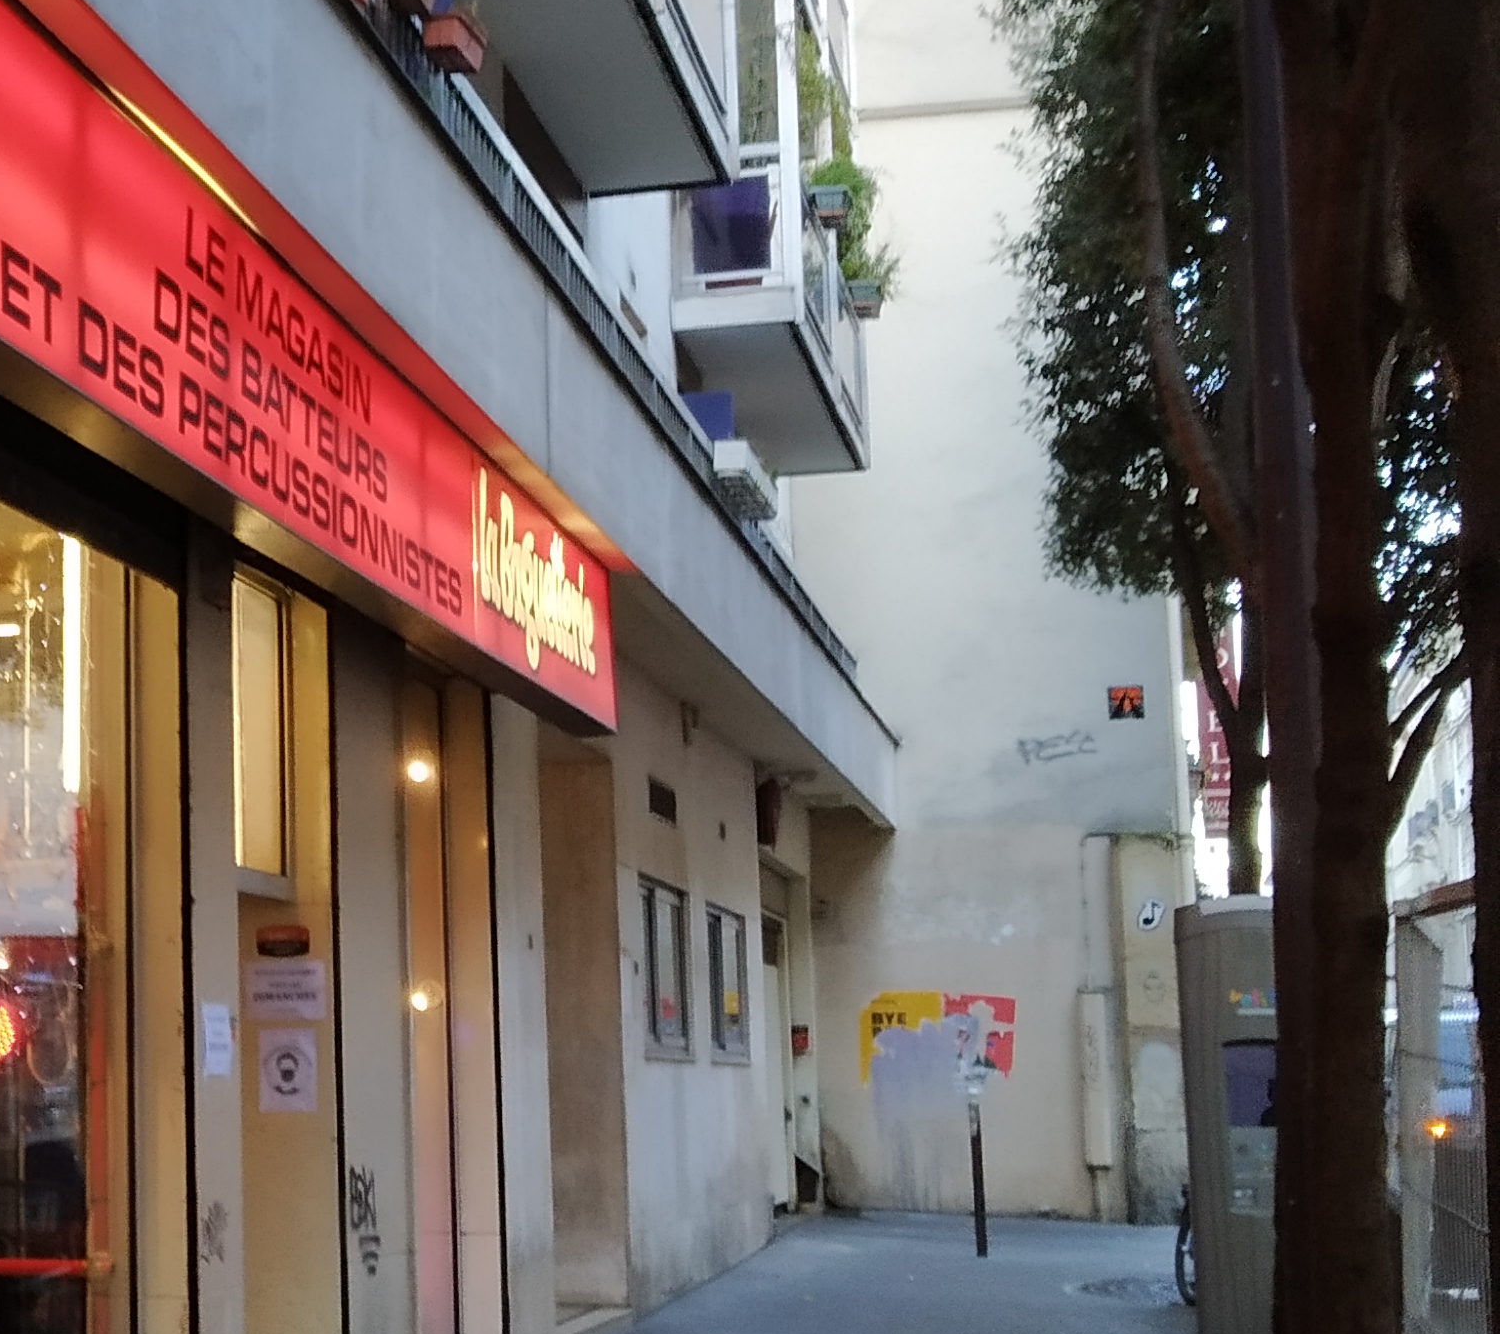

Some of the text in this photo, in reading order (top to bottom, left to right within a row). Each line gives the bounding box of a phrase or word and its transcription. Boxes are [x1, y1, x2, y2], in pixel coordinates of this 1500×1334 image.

[0, 238, 463, 618] ET DES PERCUSSIONNISTES
[153, 265, 388, 504] DES BATTEURS
[184, 204, 371, 425] LE MAGASIN
